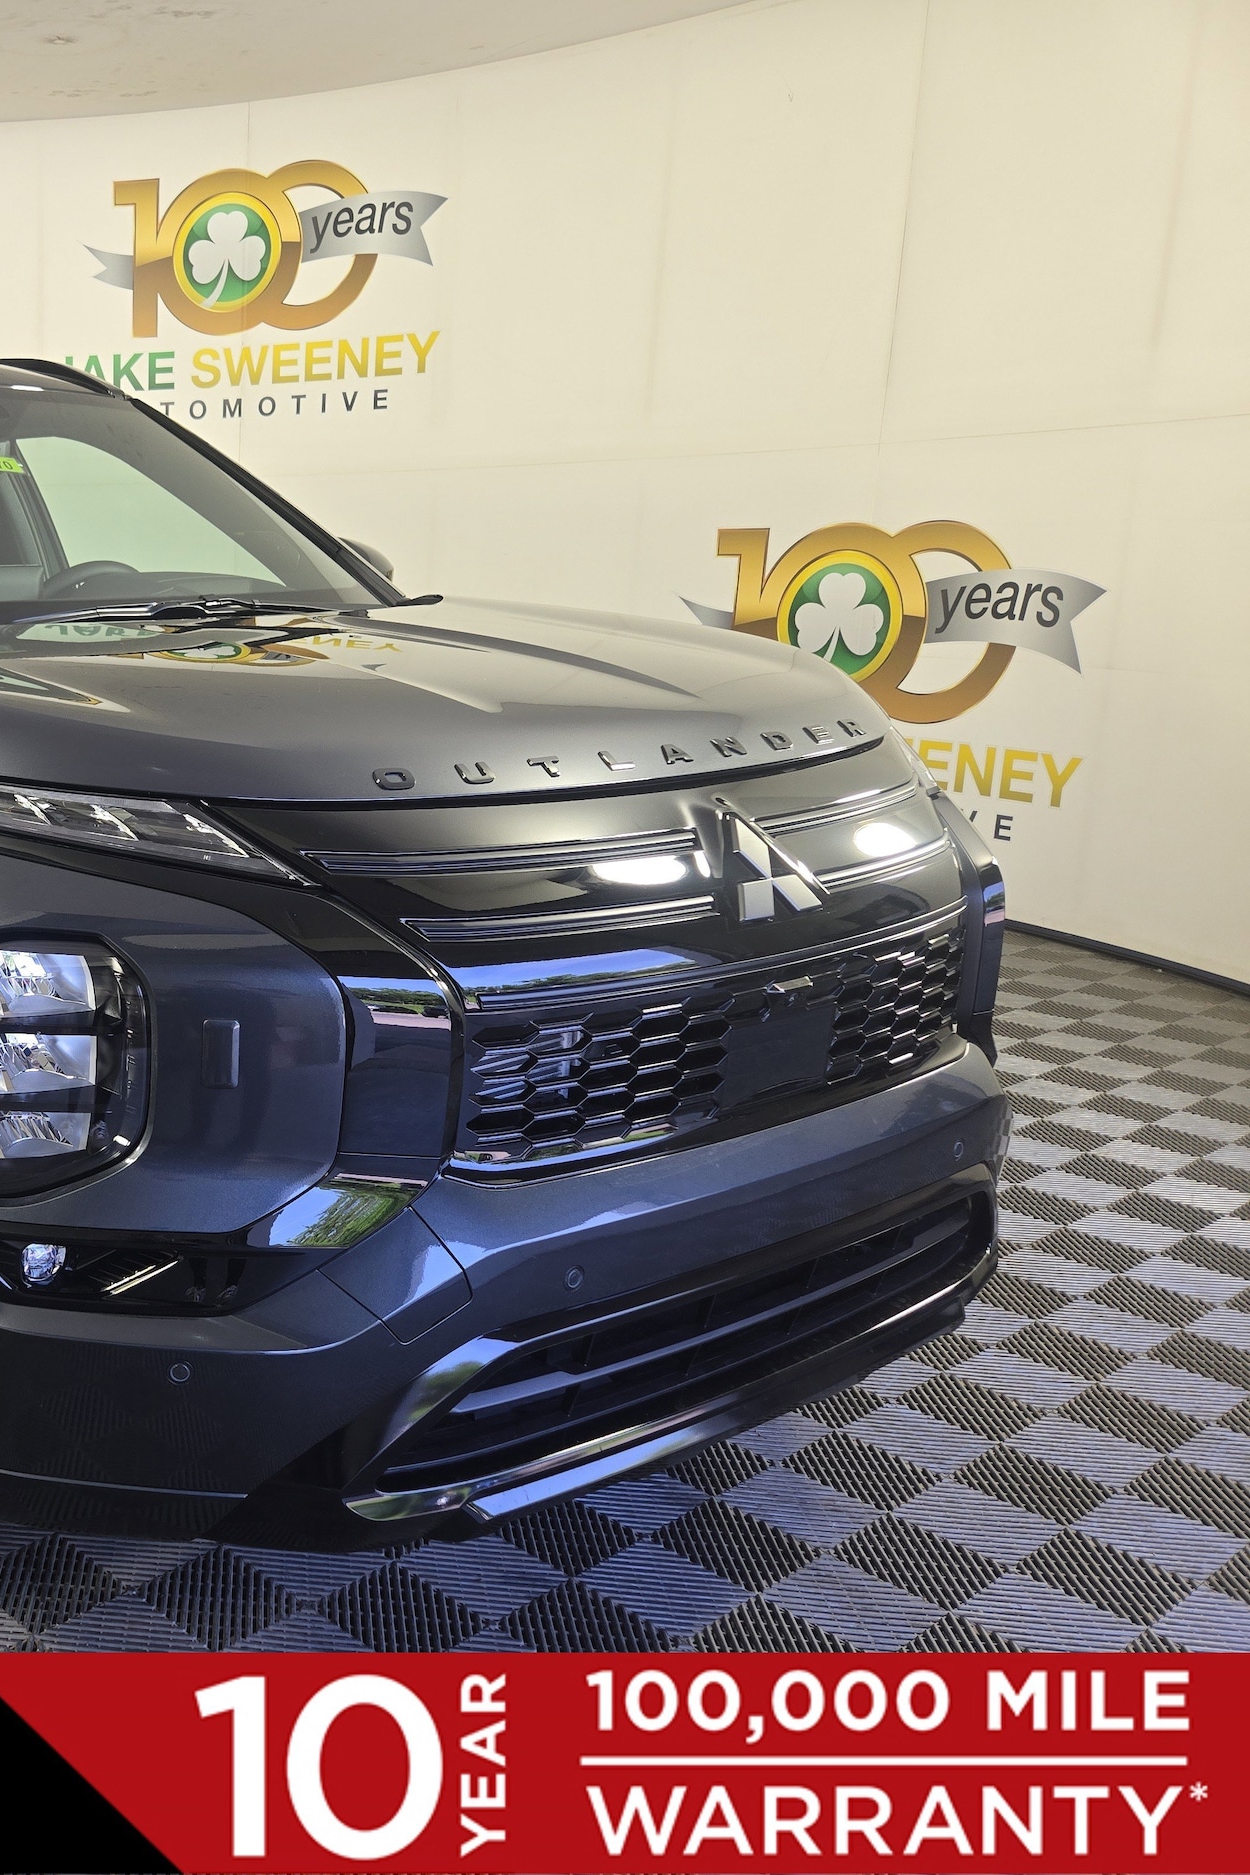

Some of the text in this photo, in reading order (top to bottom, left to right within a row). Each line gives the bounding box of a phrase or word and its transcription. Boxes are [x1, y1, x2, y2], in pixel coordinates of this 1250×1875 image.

[113, 159, 378, 339] 100
[309, 196, 414, 255] years
[64, 330, 441, 393] AKE SWEENEY
[160, 388, 390, 420] TOMOTIVE
[934, 579, 1065, 635] years
[372, 717, 867, 791] OUTLANDER
